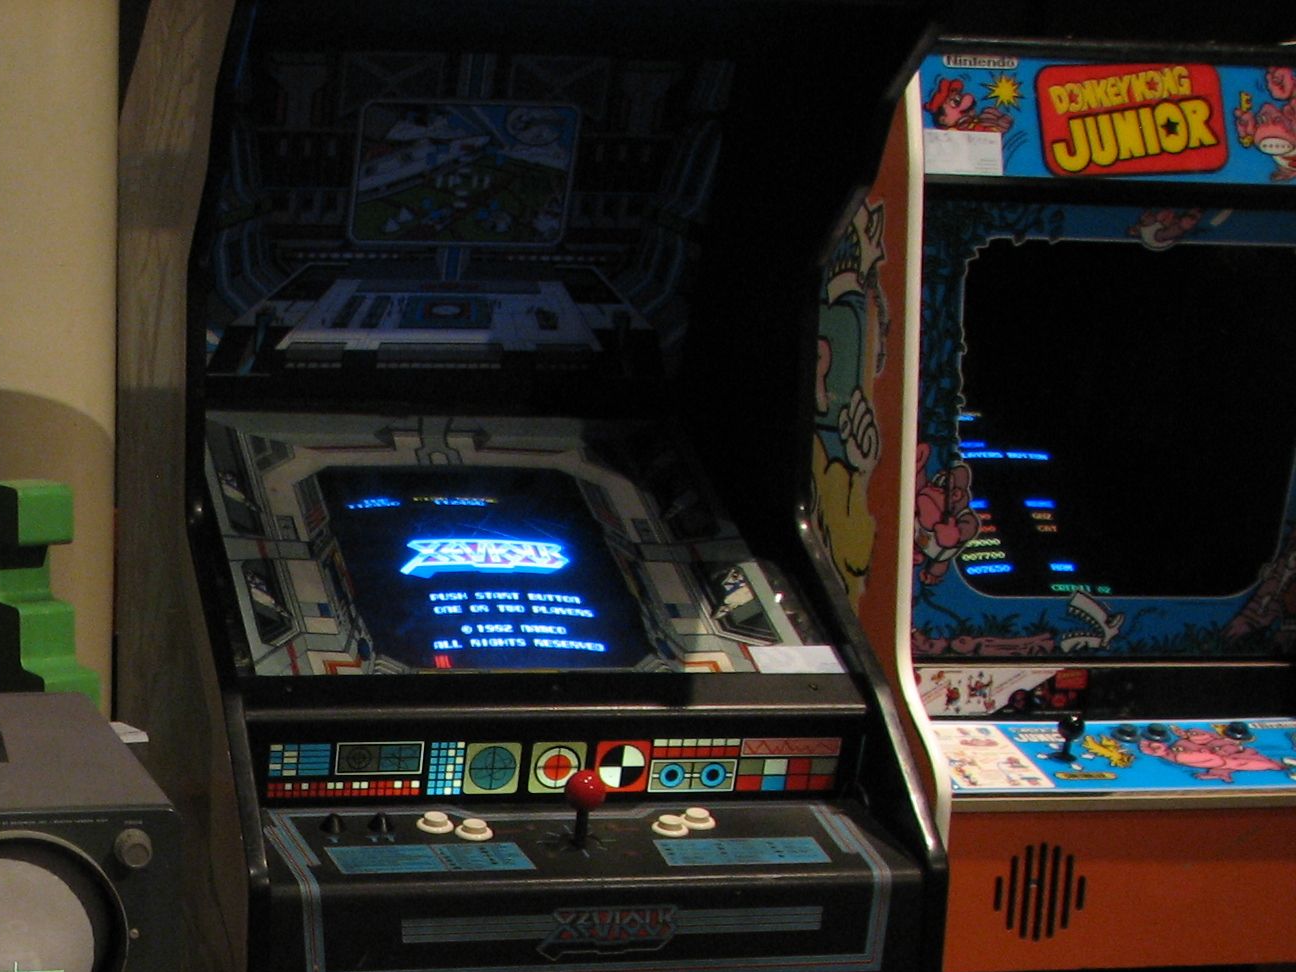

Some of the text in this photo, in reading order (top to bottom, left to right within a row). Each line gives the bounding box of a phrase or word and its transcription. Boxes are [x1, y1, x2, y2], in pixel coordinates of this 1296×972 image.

[946, 55, 1016, 67] Nintendo
[1048, 66, 1193, 115] DONKEY KONG
[1052, 97, 1218, 172] JUNIOR
[429, 591, 582, 604] PUSH START BUTTON
[433, 603, 595, 618] ONE OR TWO PLAYERS
[520, 624, 567, 635] NAMCO
[433, 637, 606, 652] ALL RIGHTS RESERVED
